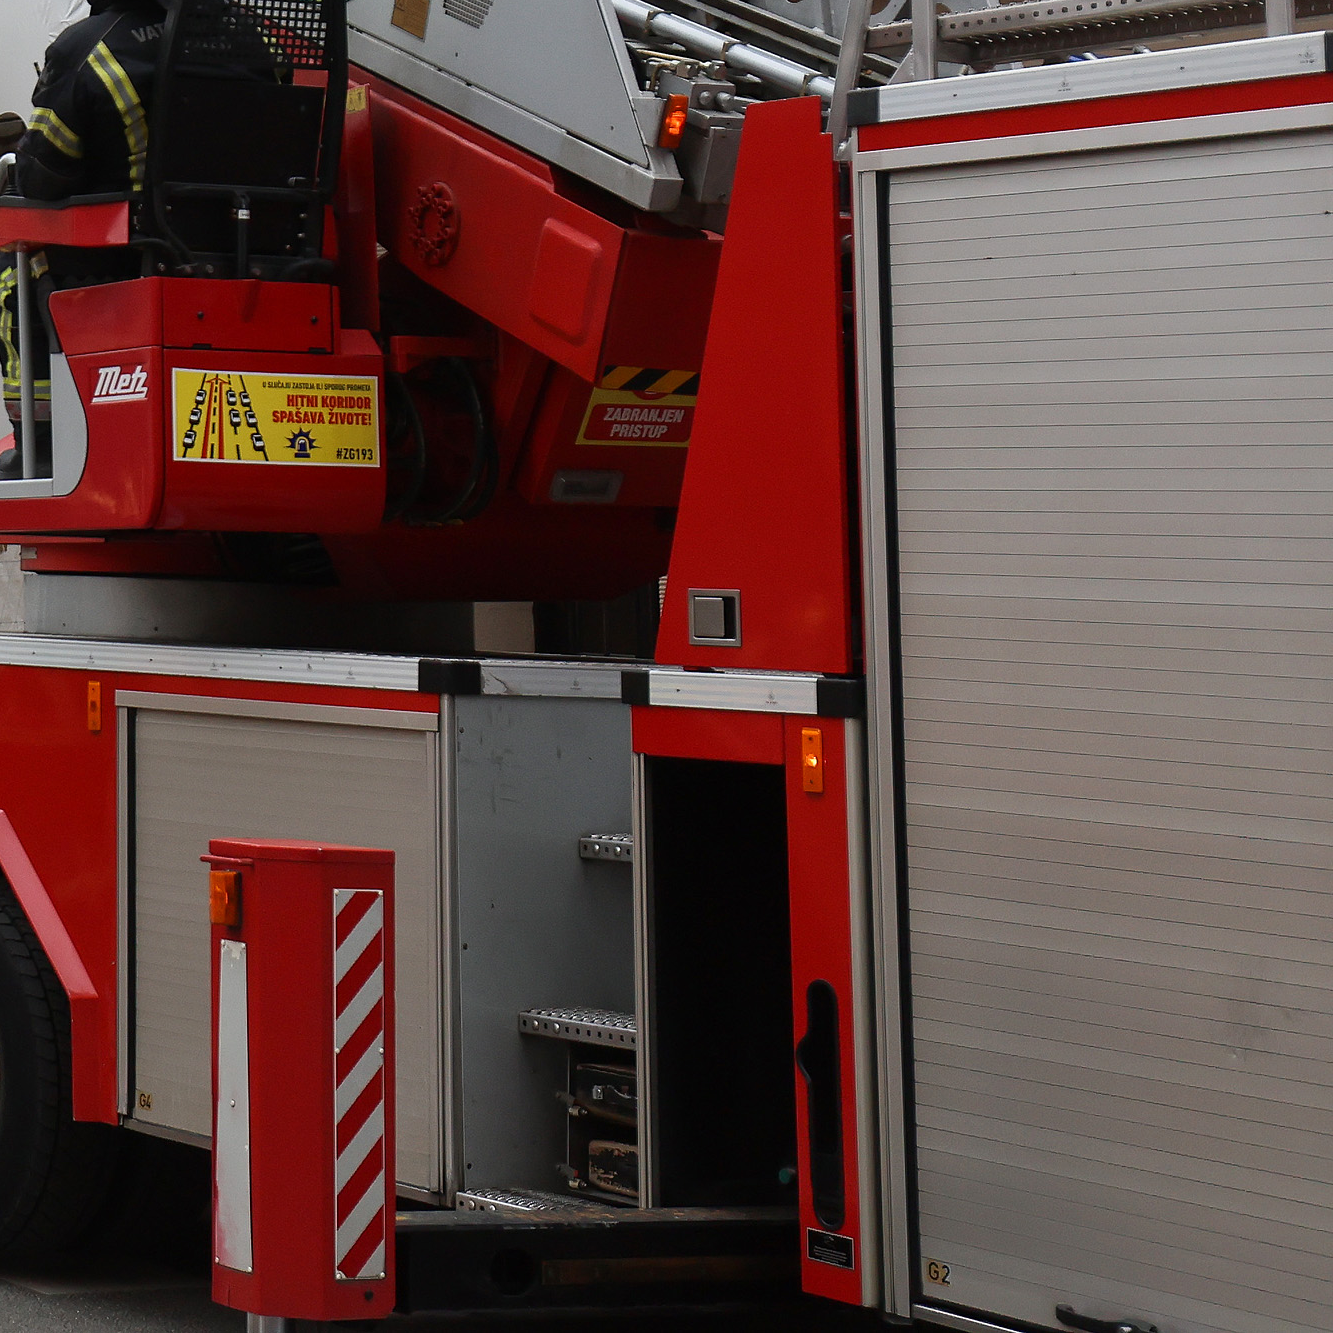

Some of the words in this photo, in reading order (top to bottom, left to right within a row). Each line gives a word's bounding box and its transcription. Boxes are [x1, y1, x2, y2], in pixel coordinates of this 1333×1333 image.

[91, 365, 149, 403] Metz
[287, 394, 319, 408] HITNI
[321, 395, 371, 409] KORIDOR
[272, 407, 326, 424] SPAŠAVA
[328, 408, 372, 426] ŽIVOTE!
[603, 407, 685, 423] ZABRANJEN
[609, 424, 668, 438] PRISTUP
[336, 448, 374, 461] #ZG193
[928, 1261, 951, 1285] G2
